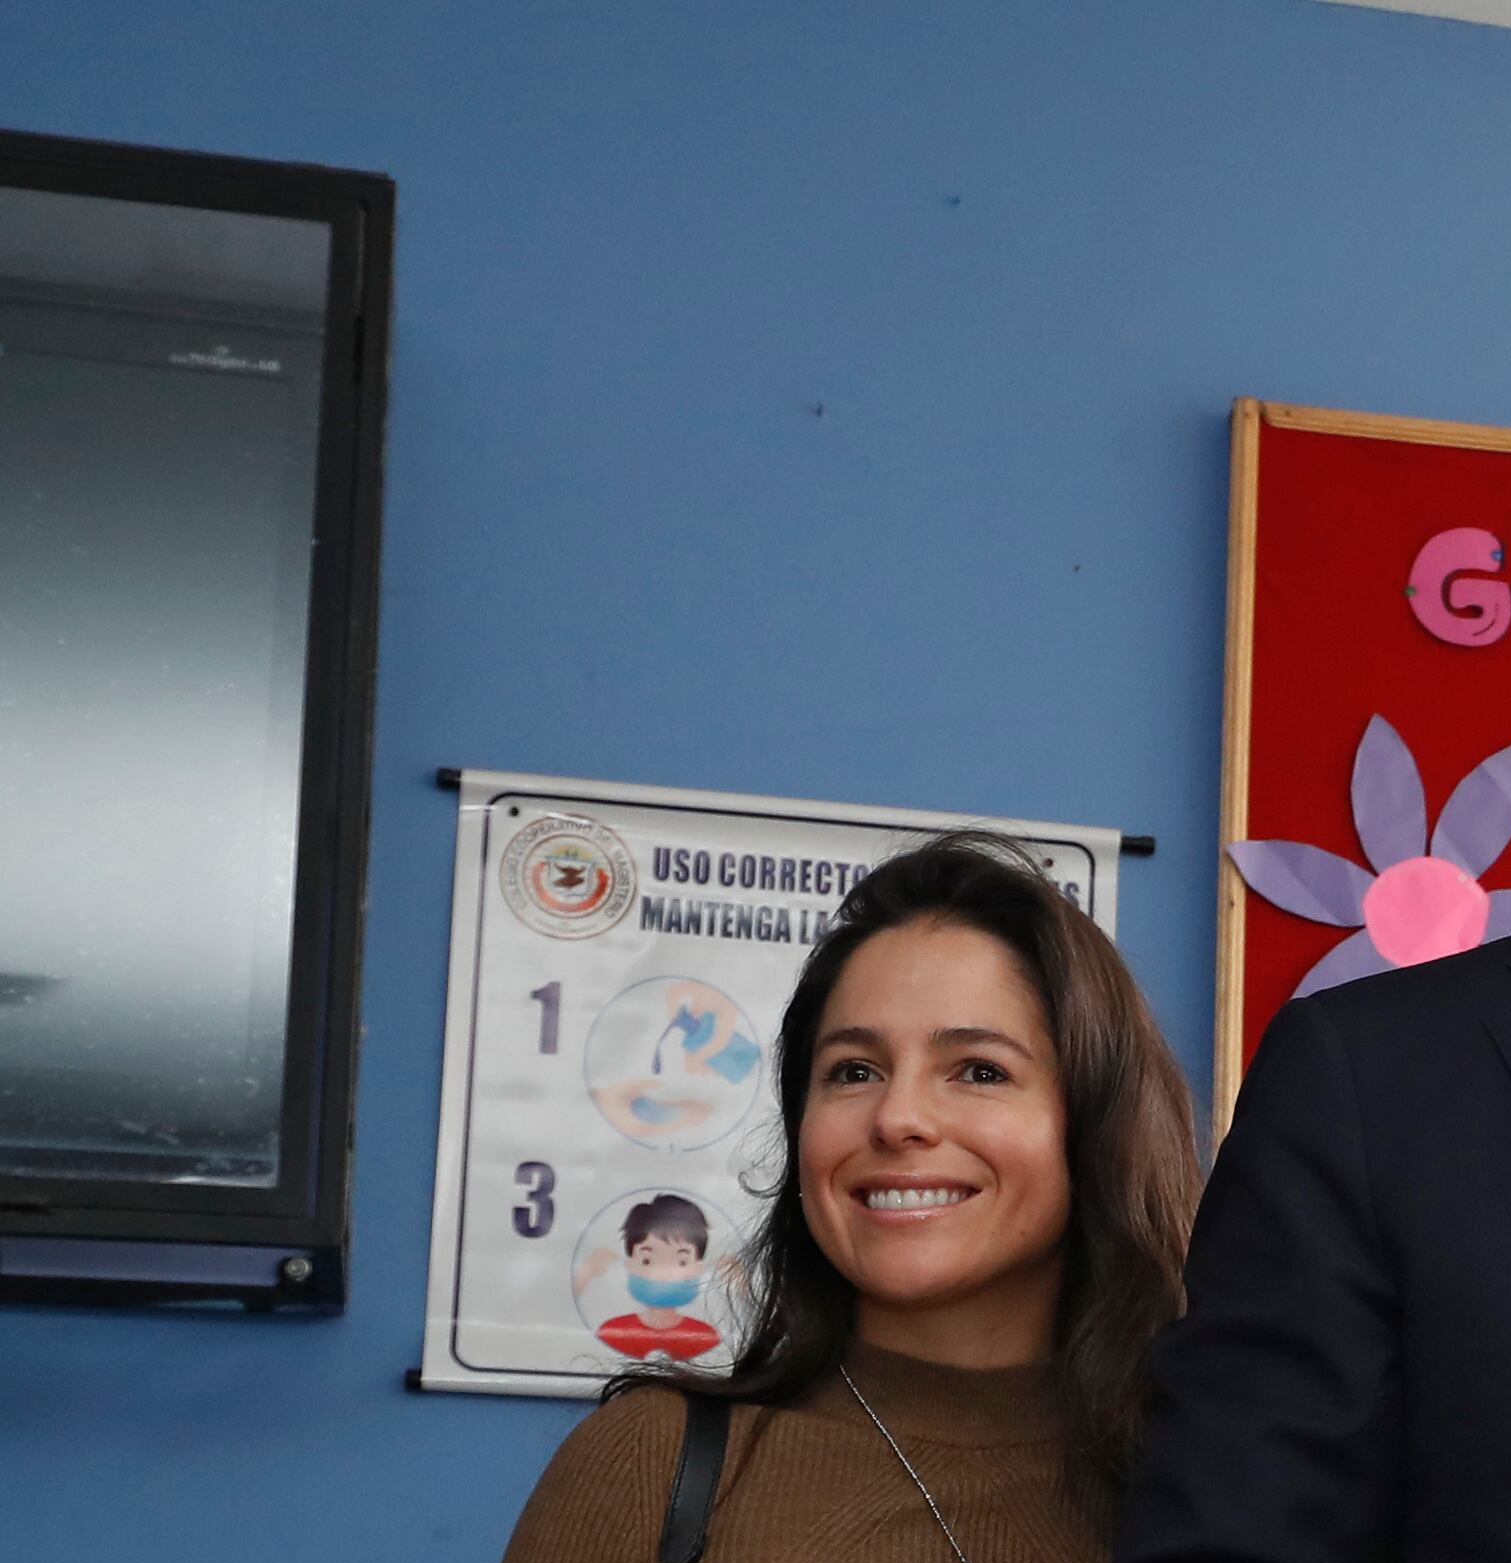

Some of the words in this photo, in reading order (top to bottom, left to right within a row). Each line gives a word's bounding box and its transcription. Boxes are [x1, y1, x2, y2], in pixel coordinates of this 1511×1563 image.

[653, 847, 711, 885] USO
[639, 895, 791, 943] MANTENGA
[529, 981, 561, 1054] 1
[511, 1160, 556, 1239] 3
